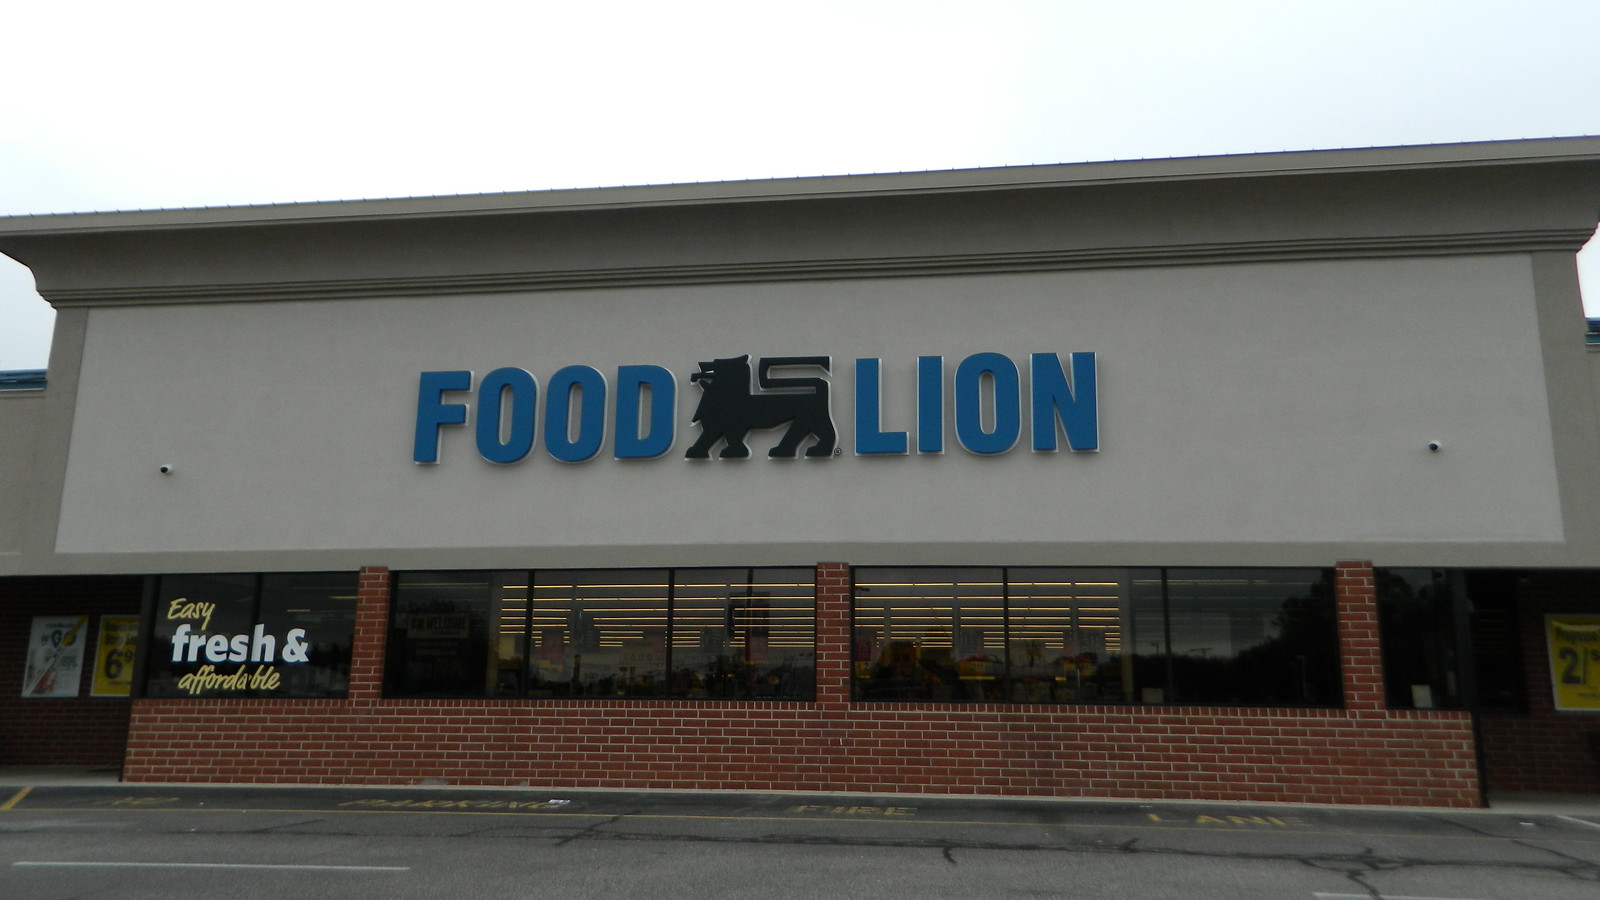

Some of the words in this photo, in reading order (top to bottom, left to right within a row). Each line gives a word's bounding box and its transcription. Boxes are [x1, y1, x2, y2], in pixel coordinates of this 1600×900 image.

[412, 364, 677, 465] FOOD
[855, 351, 1100, 456] LION
[167, 597, 215, 630] Easy
[172, 623, 276, 662] fresh
[282, 628, 309, 662] &
[178, 664, 281, 695] affordable
[787, 804, 919, 815] FIRE
